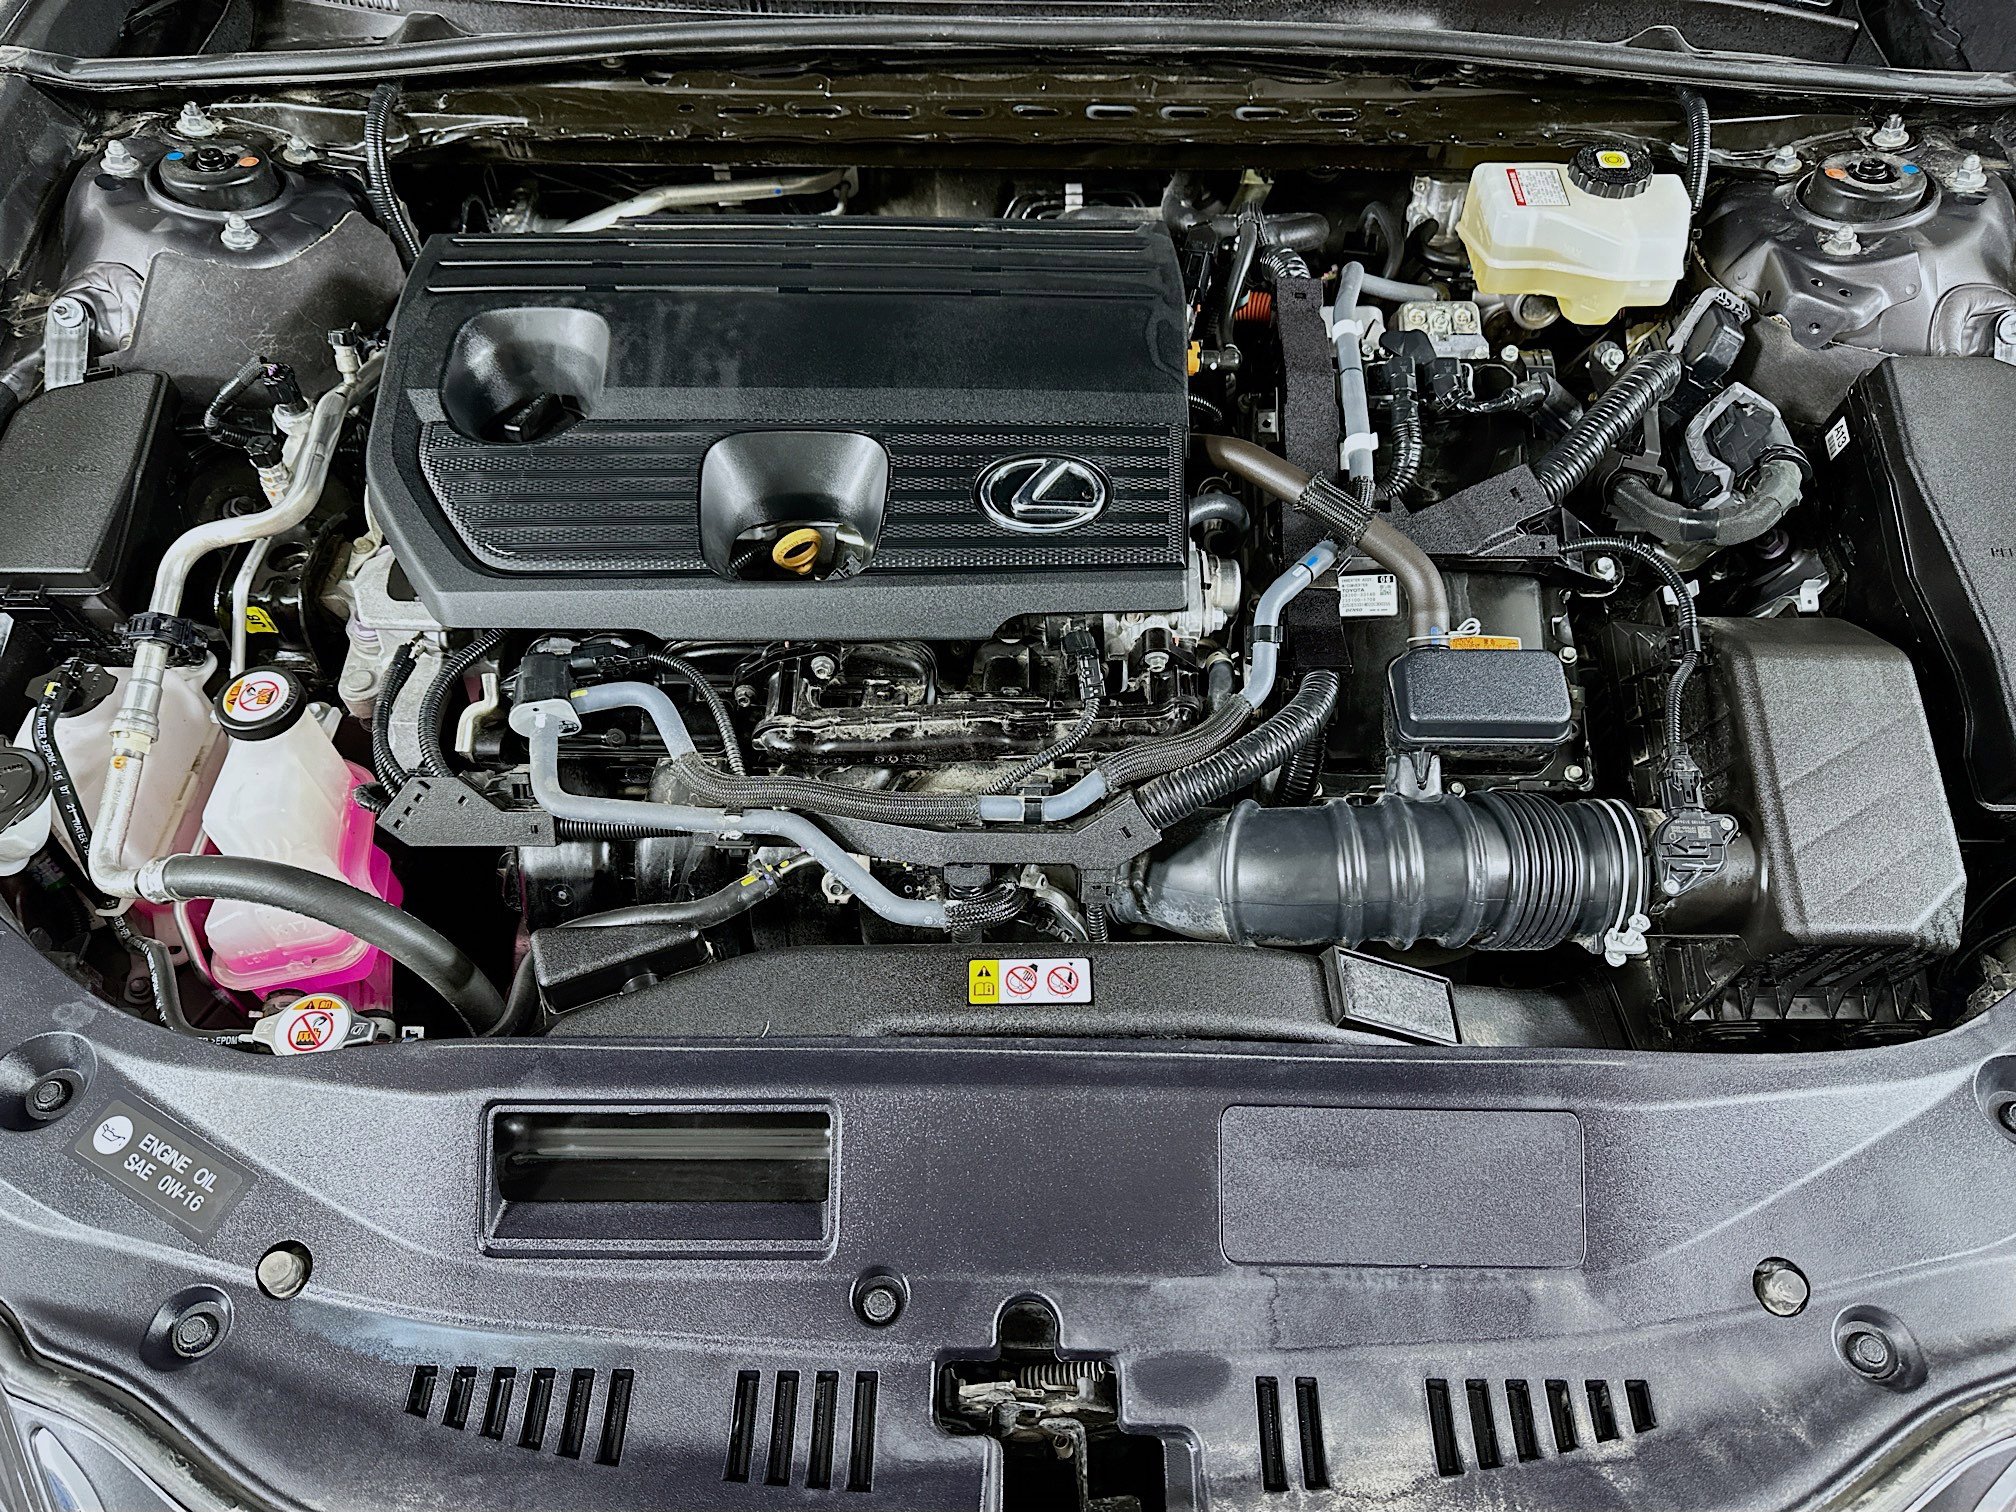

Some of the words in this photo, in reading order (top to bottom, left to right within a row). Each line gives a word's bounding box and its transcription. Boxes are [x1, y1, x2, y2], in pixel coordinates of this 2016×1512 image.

[1834, 424, 1847, 448] A13
[37, 716, 48, 739] WATER
[123, 1153, 157, 1181] SAE
[157, 1175, 205, 1212] 0W-16
[138, 1133, 192, 1174] ENGINE
[193, 1167, 217, 1193] OIL
